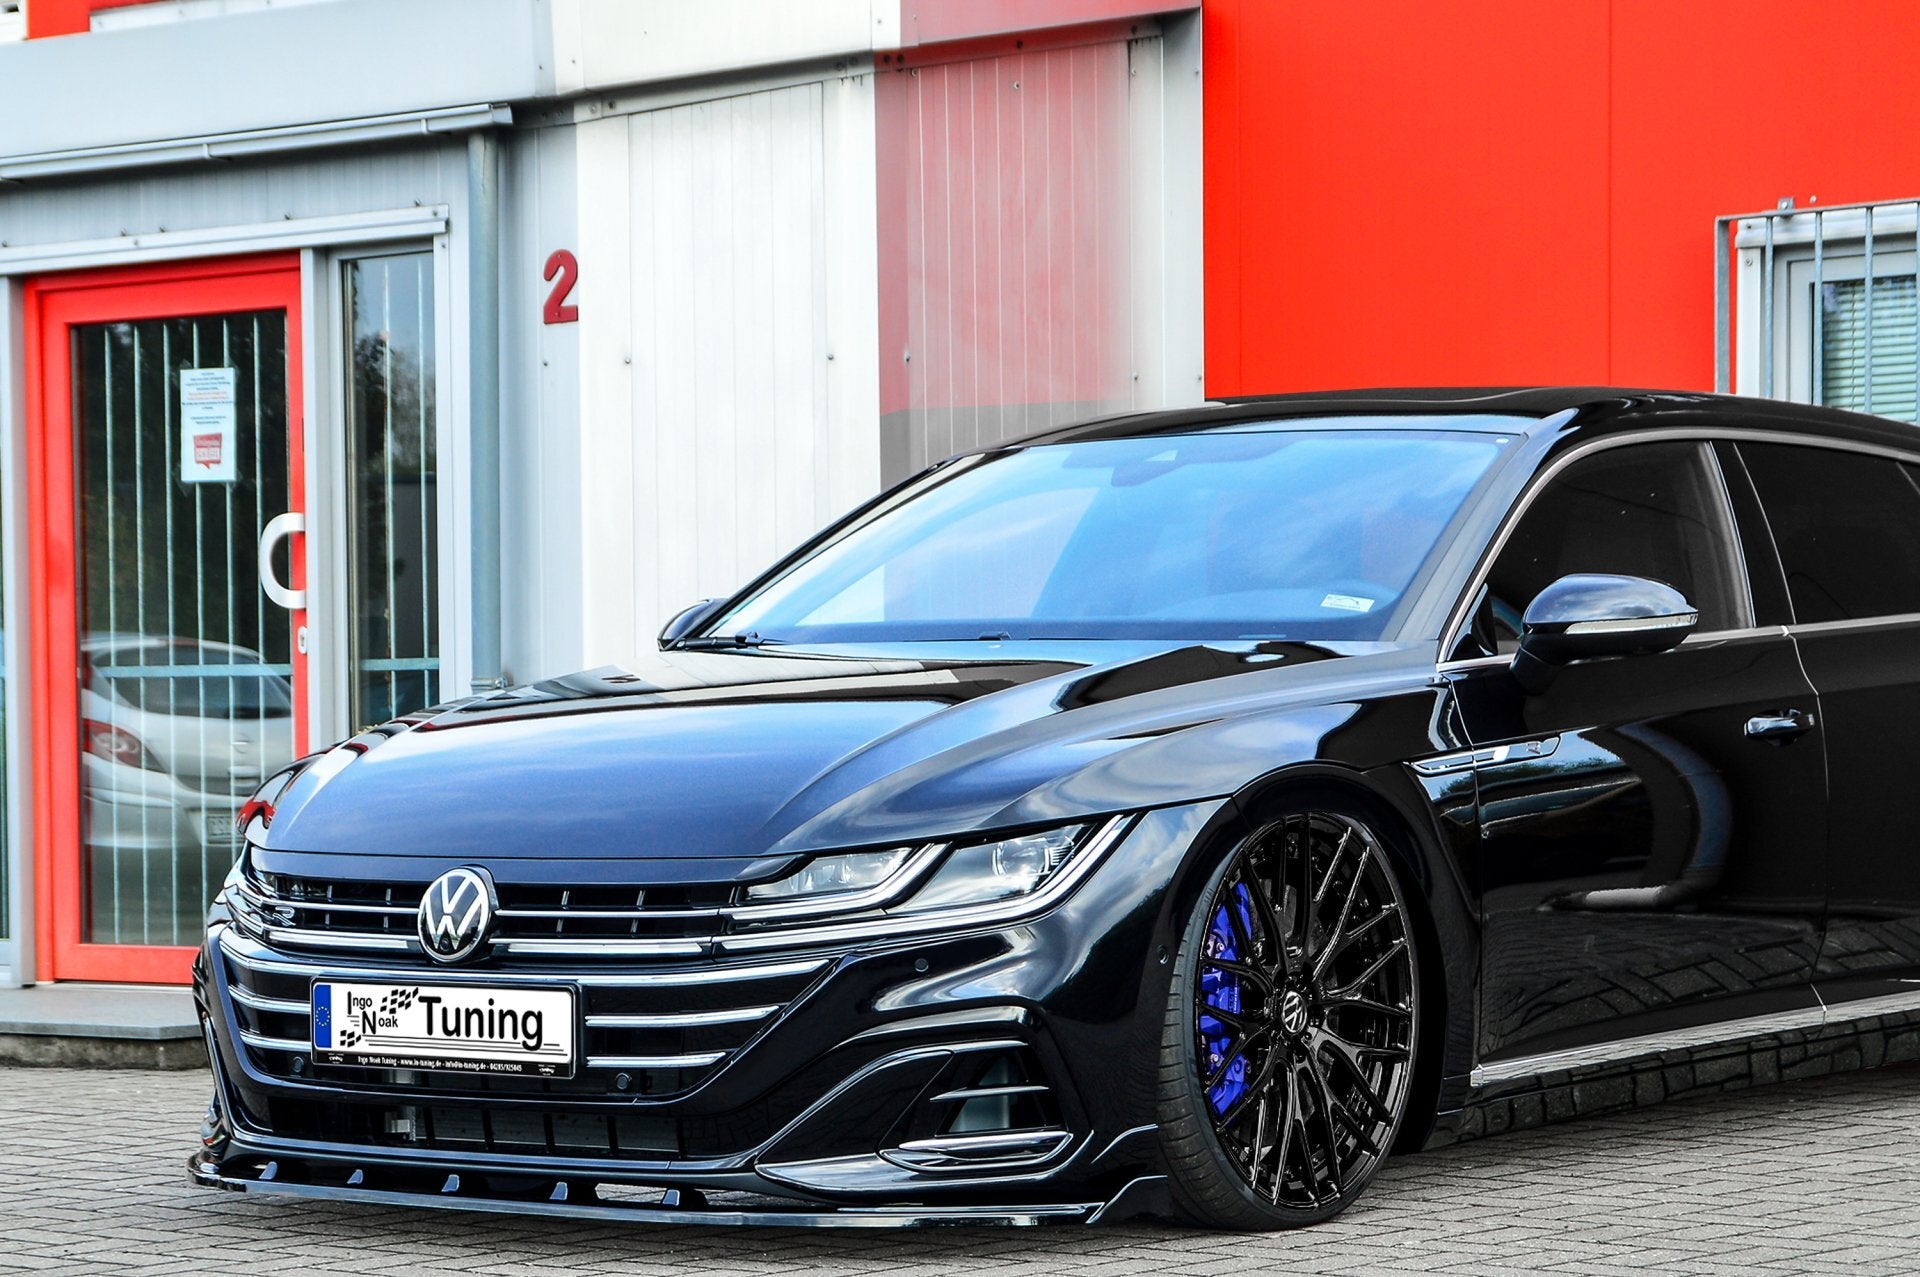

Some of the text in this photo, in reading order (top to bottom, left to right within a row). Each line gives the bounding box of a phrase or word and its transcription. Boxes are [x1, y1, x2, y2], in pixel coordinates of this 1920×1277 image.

[543, 249, 579, 324] 2
[346, 990, 374, 1016] Ingo
[361, 1010, 399, 1036] Noak
[417, 995, 543, 1052] Tuning
[381, 1057, 397, 1067] Tuning
